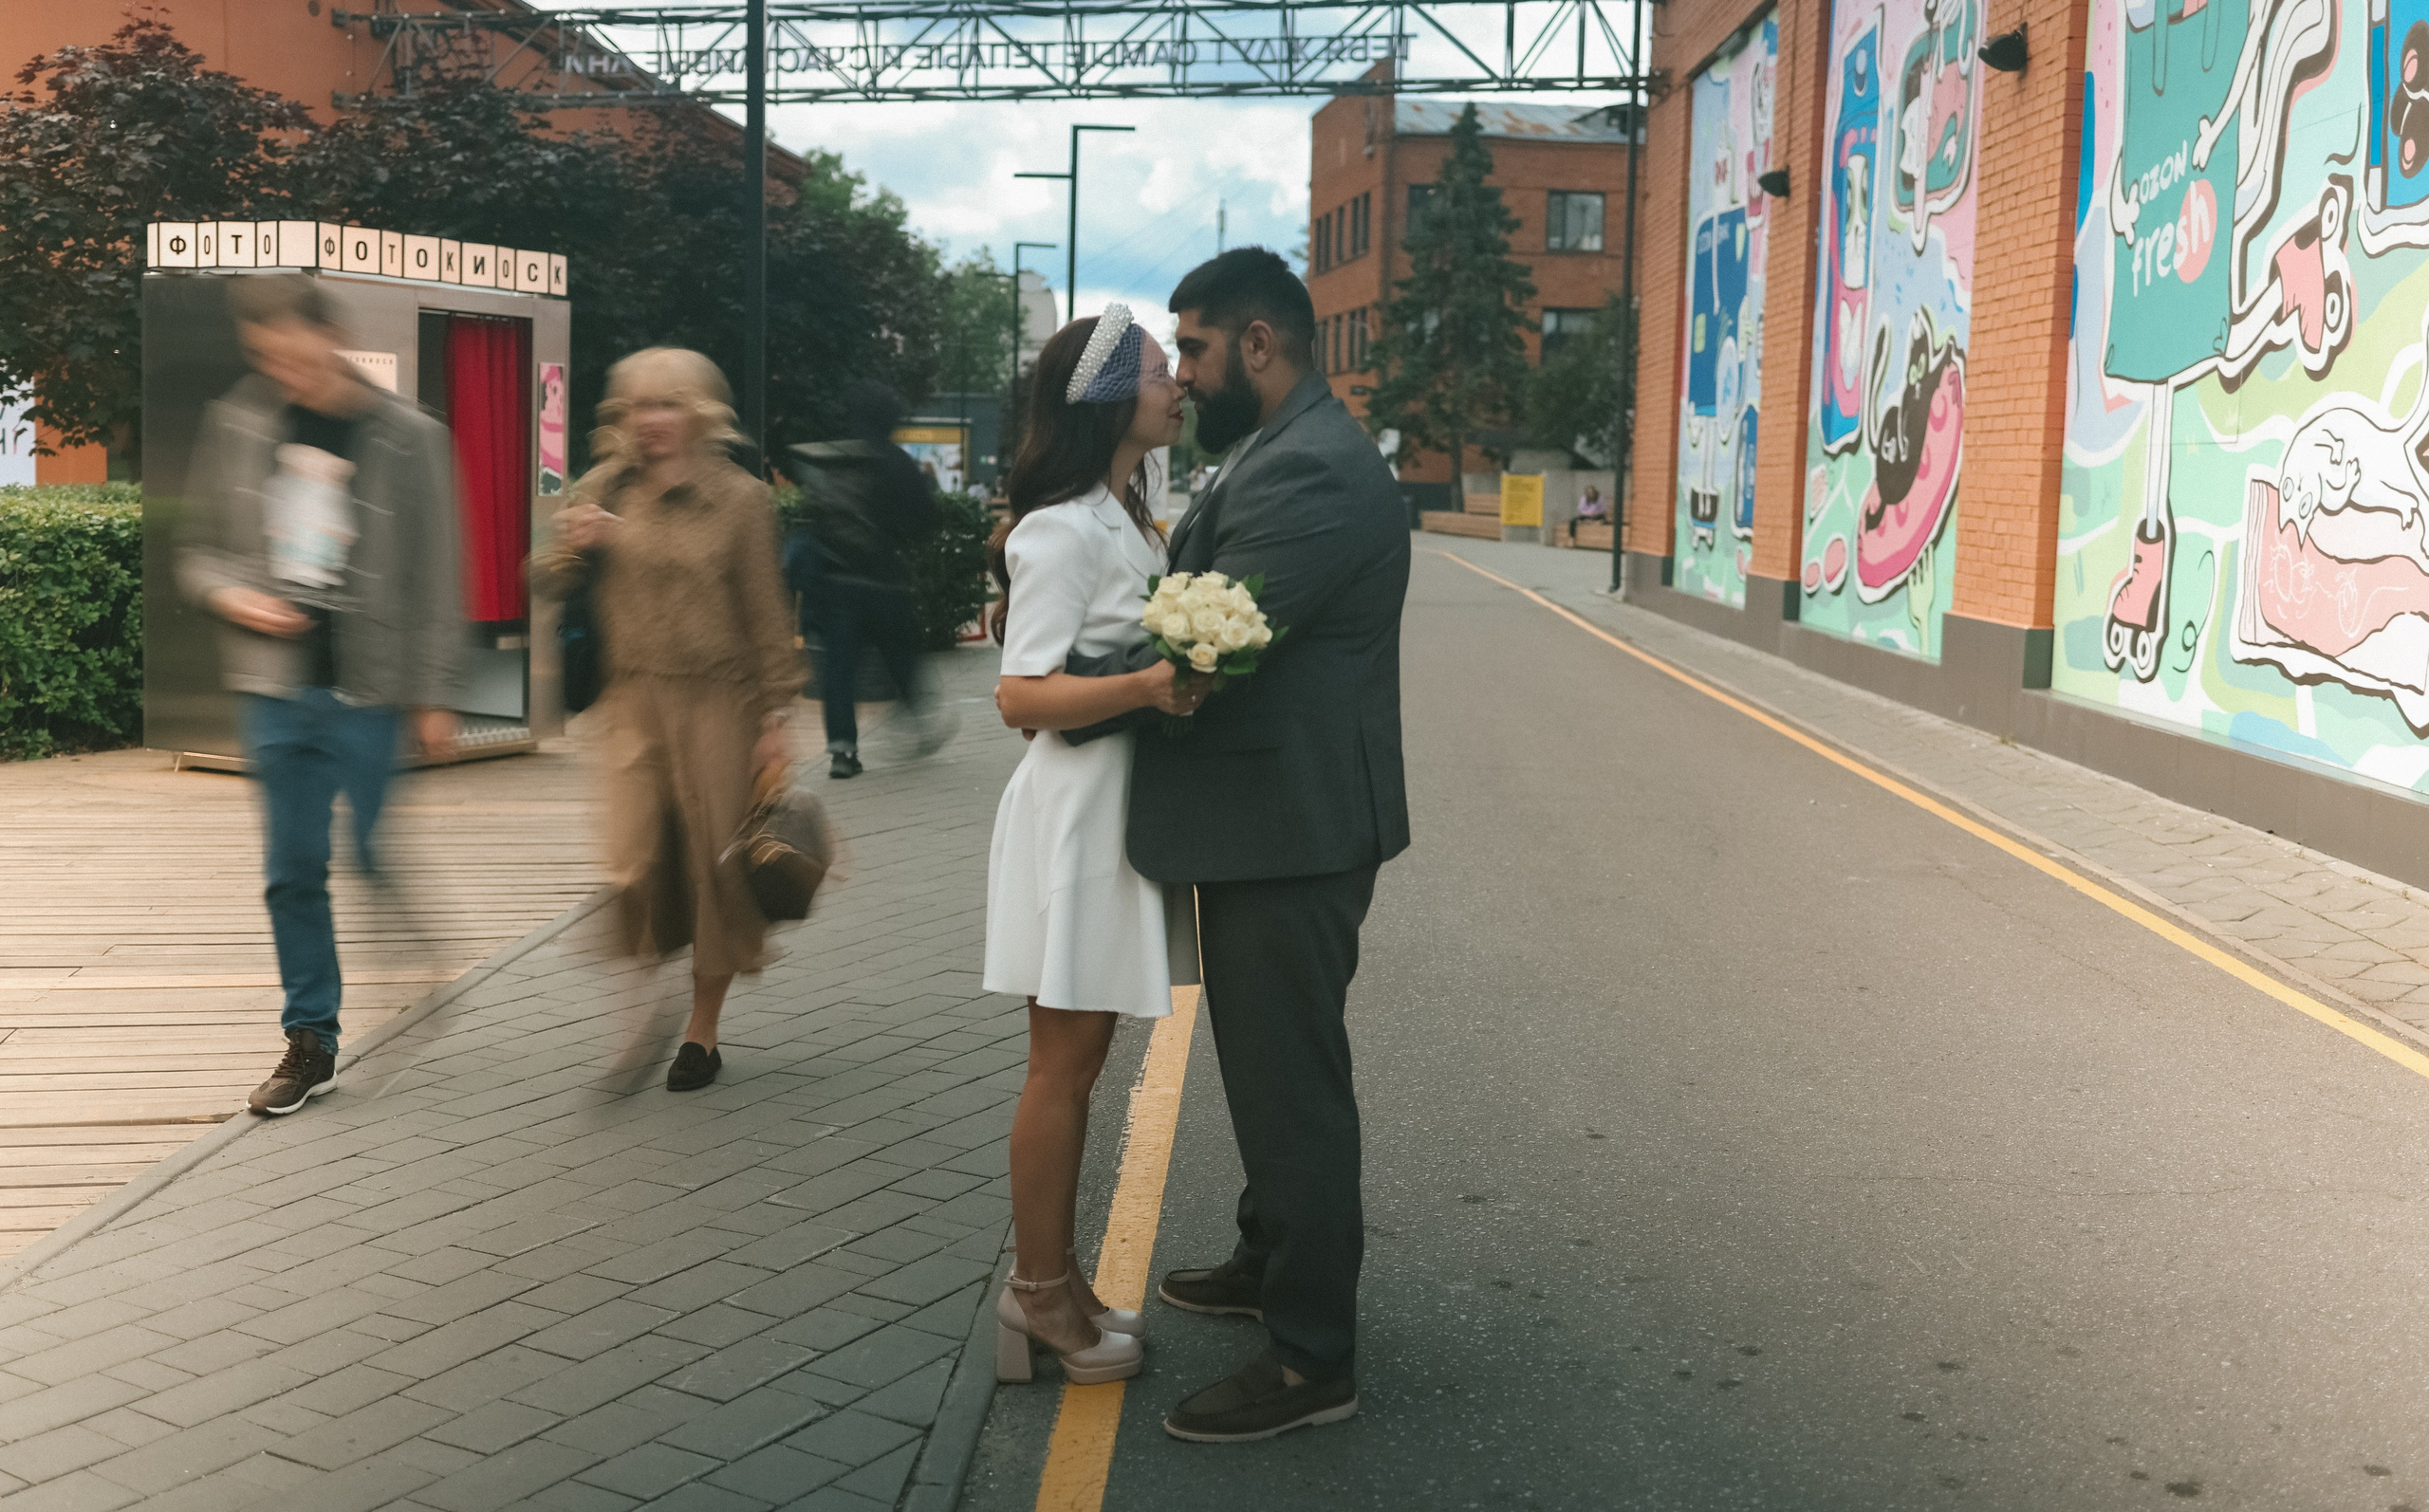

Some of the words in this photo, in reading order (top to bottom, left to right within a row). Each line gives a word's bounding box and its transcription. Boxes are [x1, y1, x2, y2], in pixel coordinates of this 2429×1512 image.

[2140, 139, 2188, 205] OZON
[169, 234, 271, 255] ФОТО
[324, 236, 562, 285] ФОТОКИОСК
[2131, 180, 2211, 297] fresh
